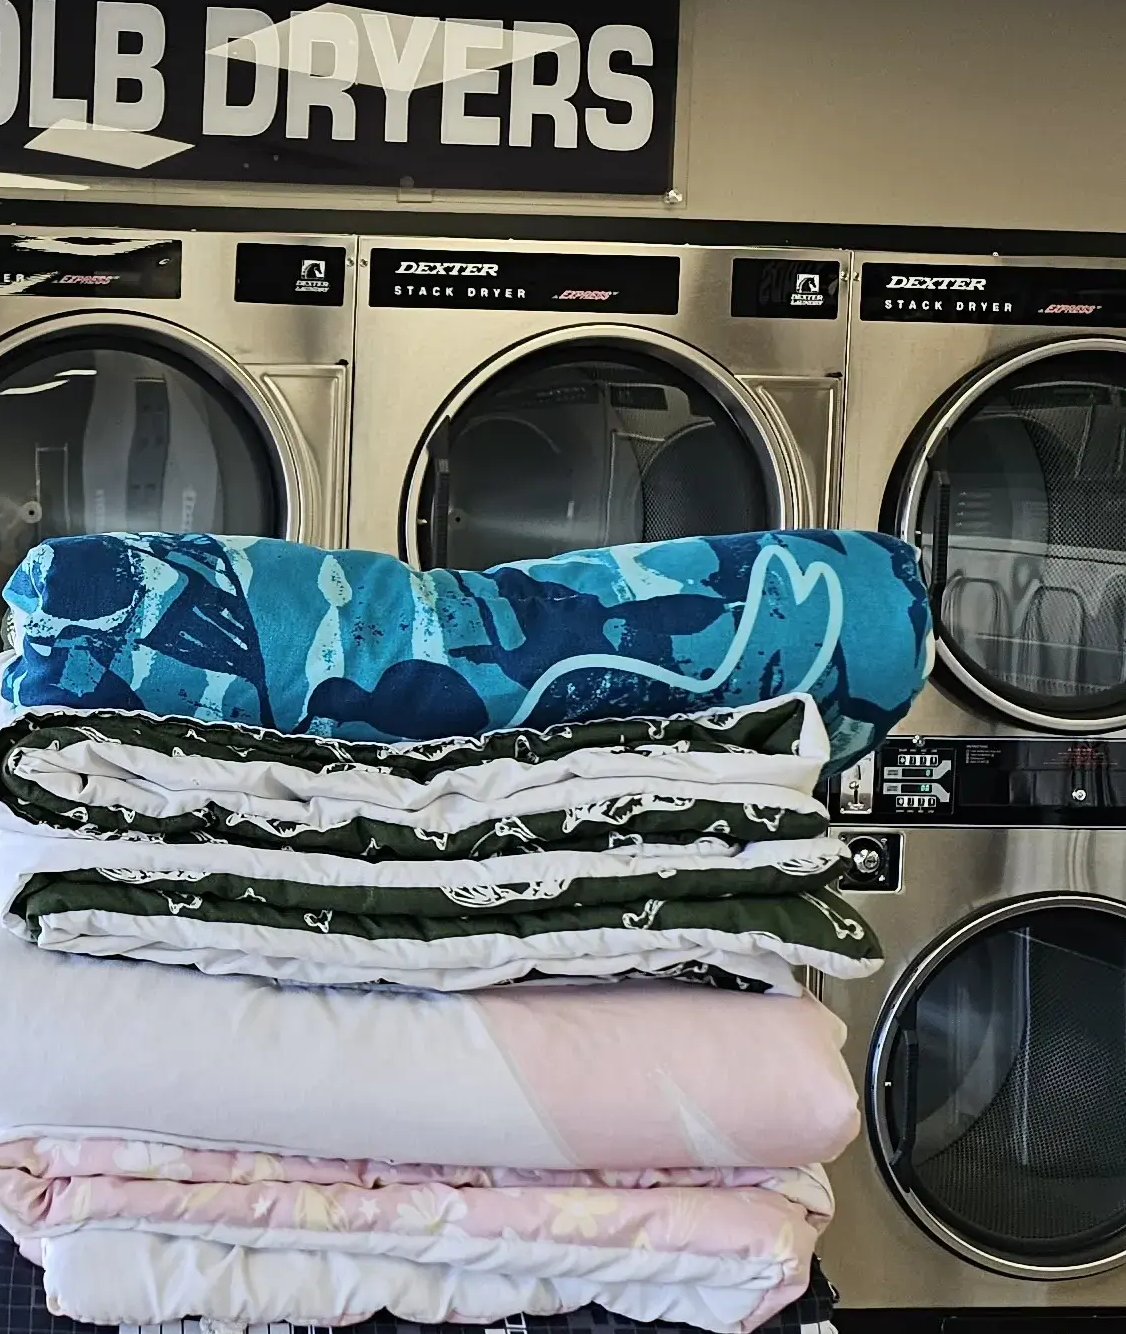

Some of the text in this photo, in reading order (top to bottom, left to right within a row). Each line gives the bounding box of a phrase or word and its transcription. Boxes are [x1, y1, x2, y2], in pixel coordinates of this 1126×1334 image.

[202, 5, 654, 152] DRYERS
[395, 261, 499, 276] DEXTER
[886, 275, 987, 290] DEXTER
[394, 285, 526, 299] STACK DRYER
[884, 299, 1013, 313] STACK DRYER
